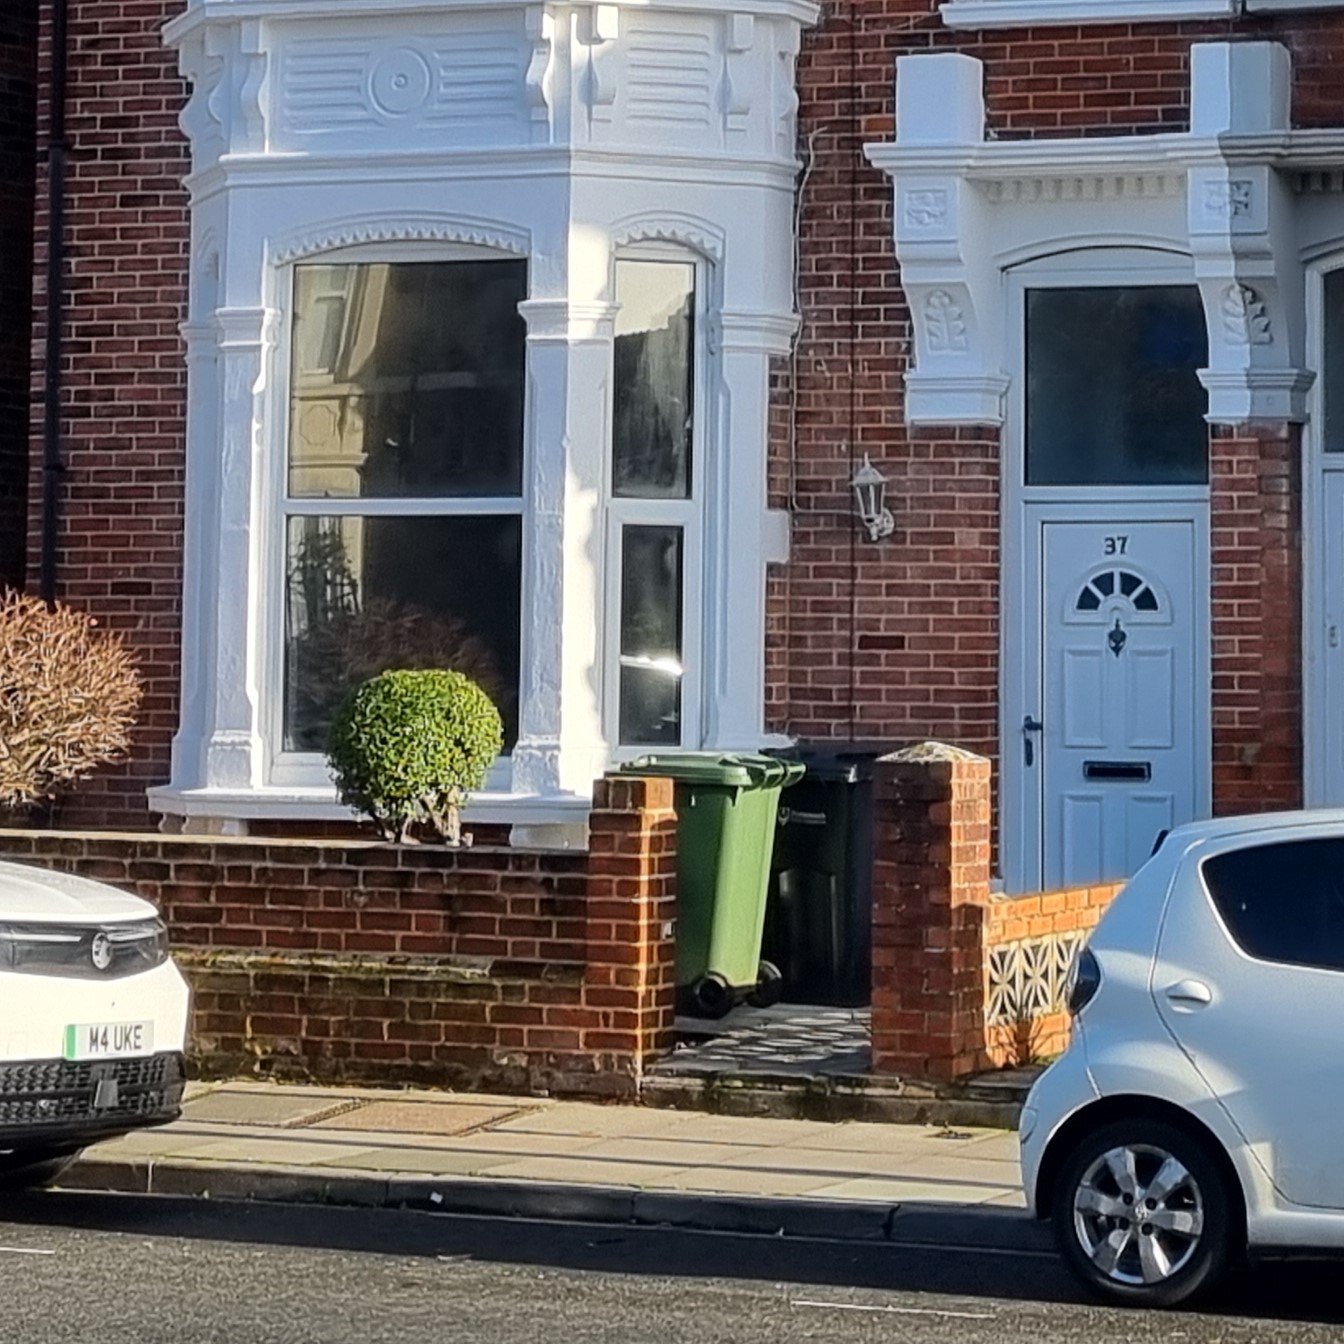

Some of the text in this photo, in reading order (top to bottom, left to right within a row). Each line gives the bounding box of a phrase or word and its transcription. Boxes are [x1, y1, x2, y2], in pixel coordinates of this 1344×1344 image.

[1104, 535, 1129, 555] 37
[89, 1024, 143, 1053] M4 UKE
